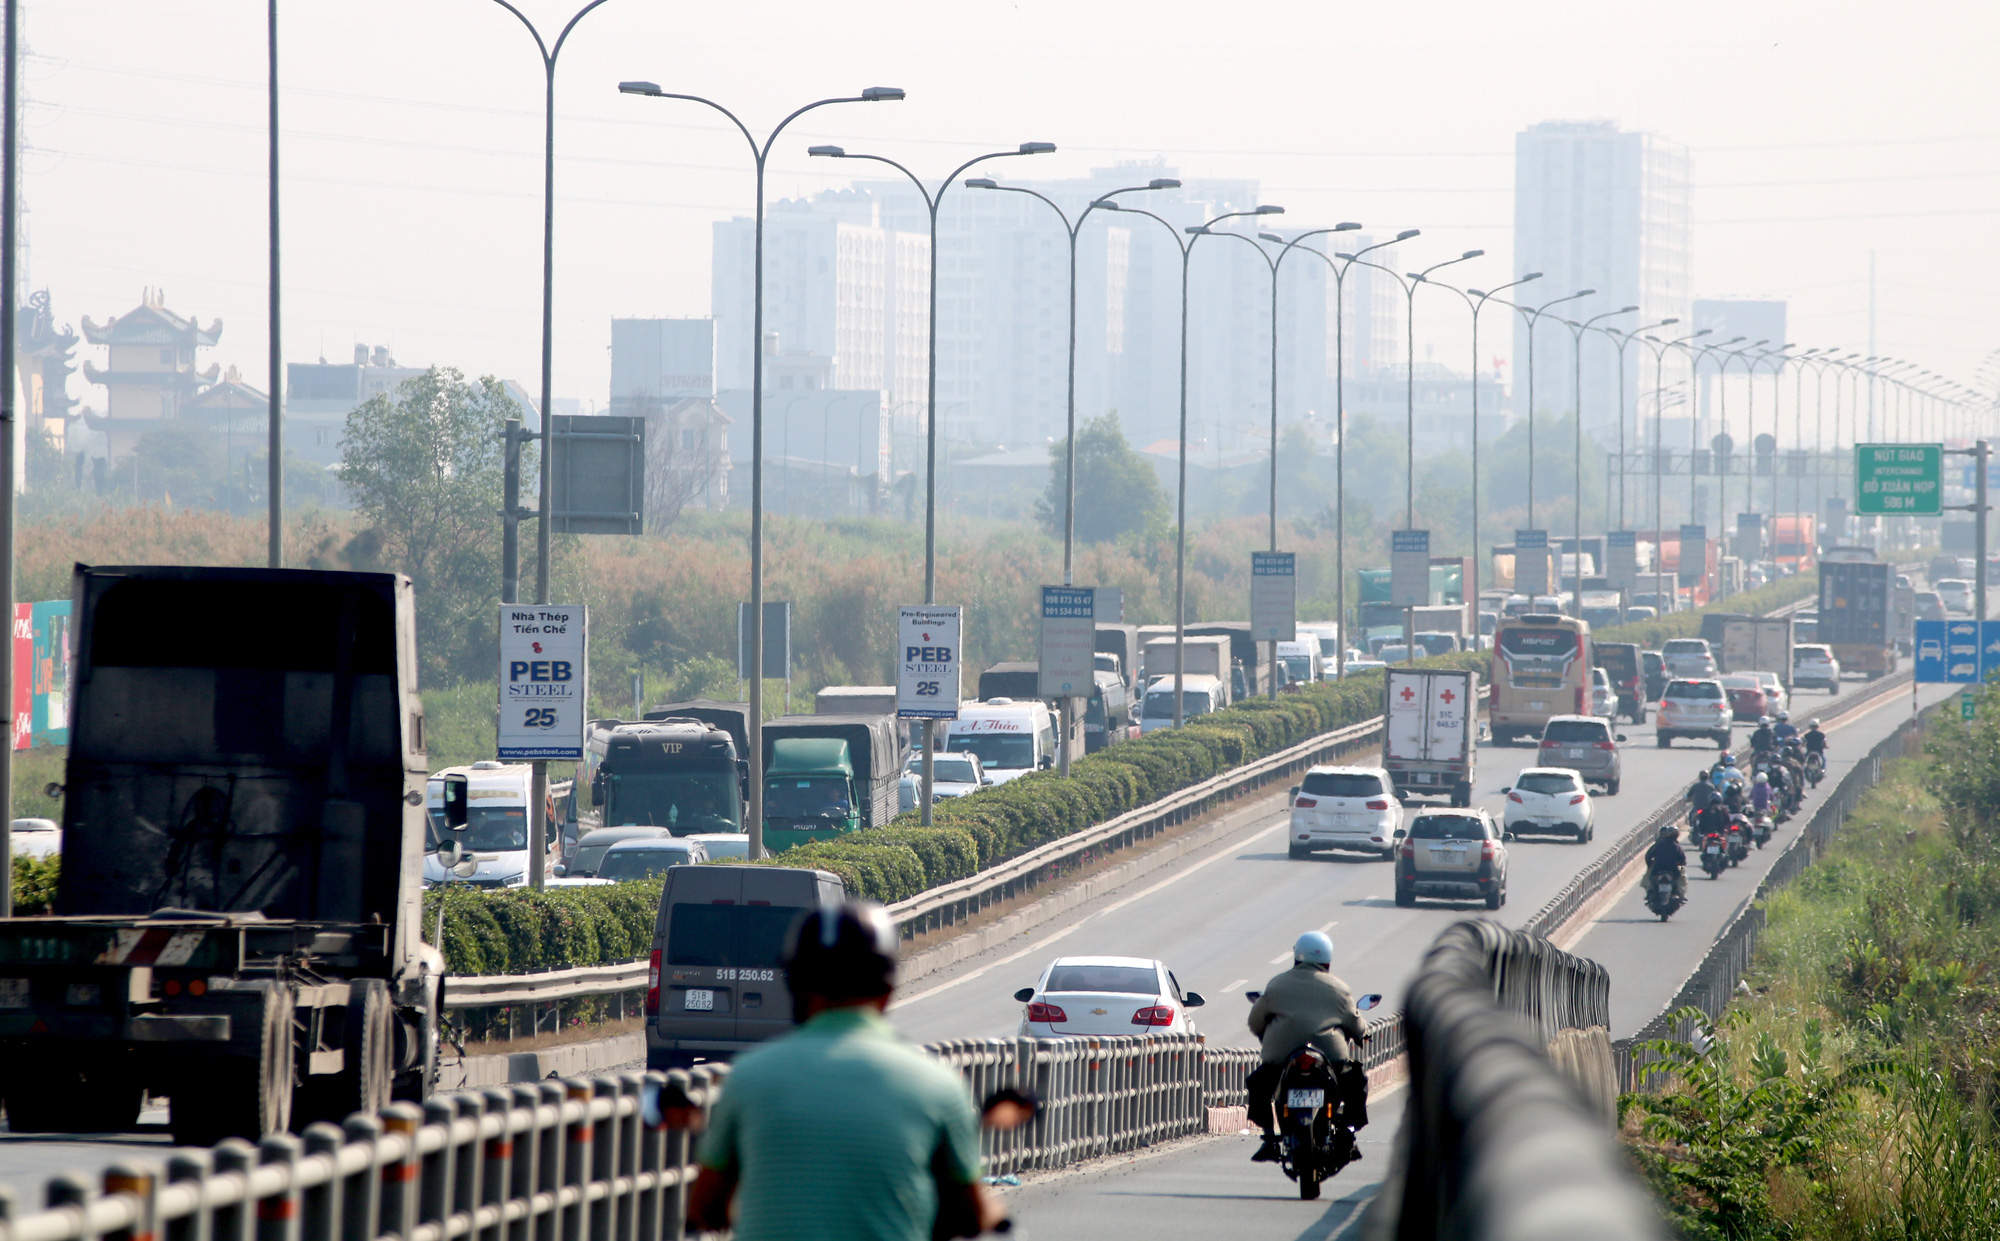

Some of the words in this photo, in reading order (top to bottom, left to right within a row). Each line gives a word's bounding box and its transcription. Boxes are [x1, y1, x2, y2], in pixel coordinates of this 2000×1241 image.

[1874, 448, 1896, 462] NÚT
[1898, 449, 1925, 462] GIAO
[1881, 479, 1911, 493] XUÂN
[1883, 496, 1902, 508] 500
[1905, 496, 1915, 508] M
[1083, 596, 1092, 605] 47
[901, 611, 957, 619] Pre-Engineered
[1045, 607, 1058, 615] 091
[1059, 607, 1072, 616] 534
[1073, 607, 1082, 616] 45
[512, 612, 535, 621] Nhà
[538, 612, 569, 623] Thép
[912, 619, 945, 627] Buildings
[543, 624, 567, 634] Chế
[906, 646, 952, 663] PEB
[510, 661, 573, 682] PEB
[905, 664, 952, 673] STEEL
[508, 684, 573, 696] STEEL
[916, 681, 940, 696] 25
[900, 710, 955, 718] www.pebsteel.com
[1439, 711, 1453, 719] 51C
[1964, 705, 1973, 717] 2
[524, 707, 557, 728] 25
[502, 748, 577, 757] www.pebsteel.com
[662, 743, 682, 754] VIP
[716, 969, 736, 980] 51B
[738, 970, 774, 981] 250.62
[692, 991, 707, 999] 51B
